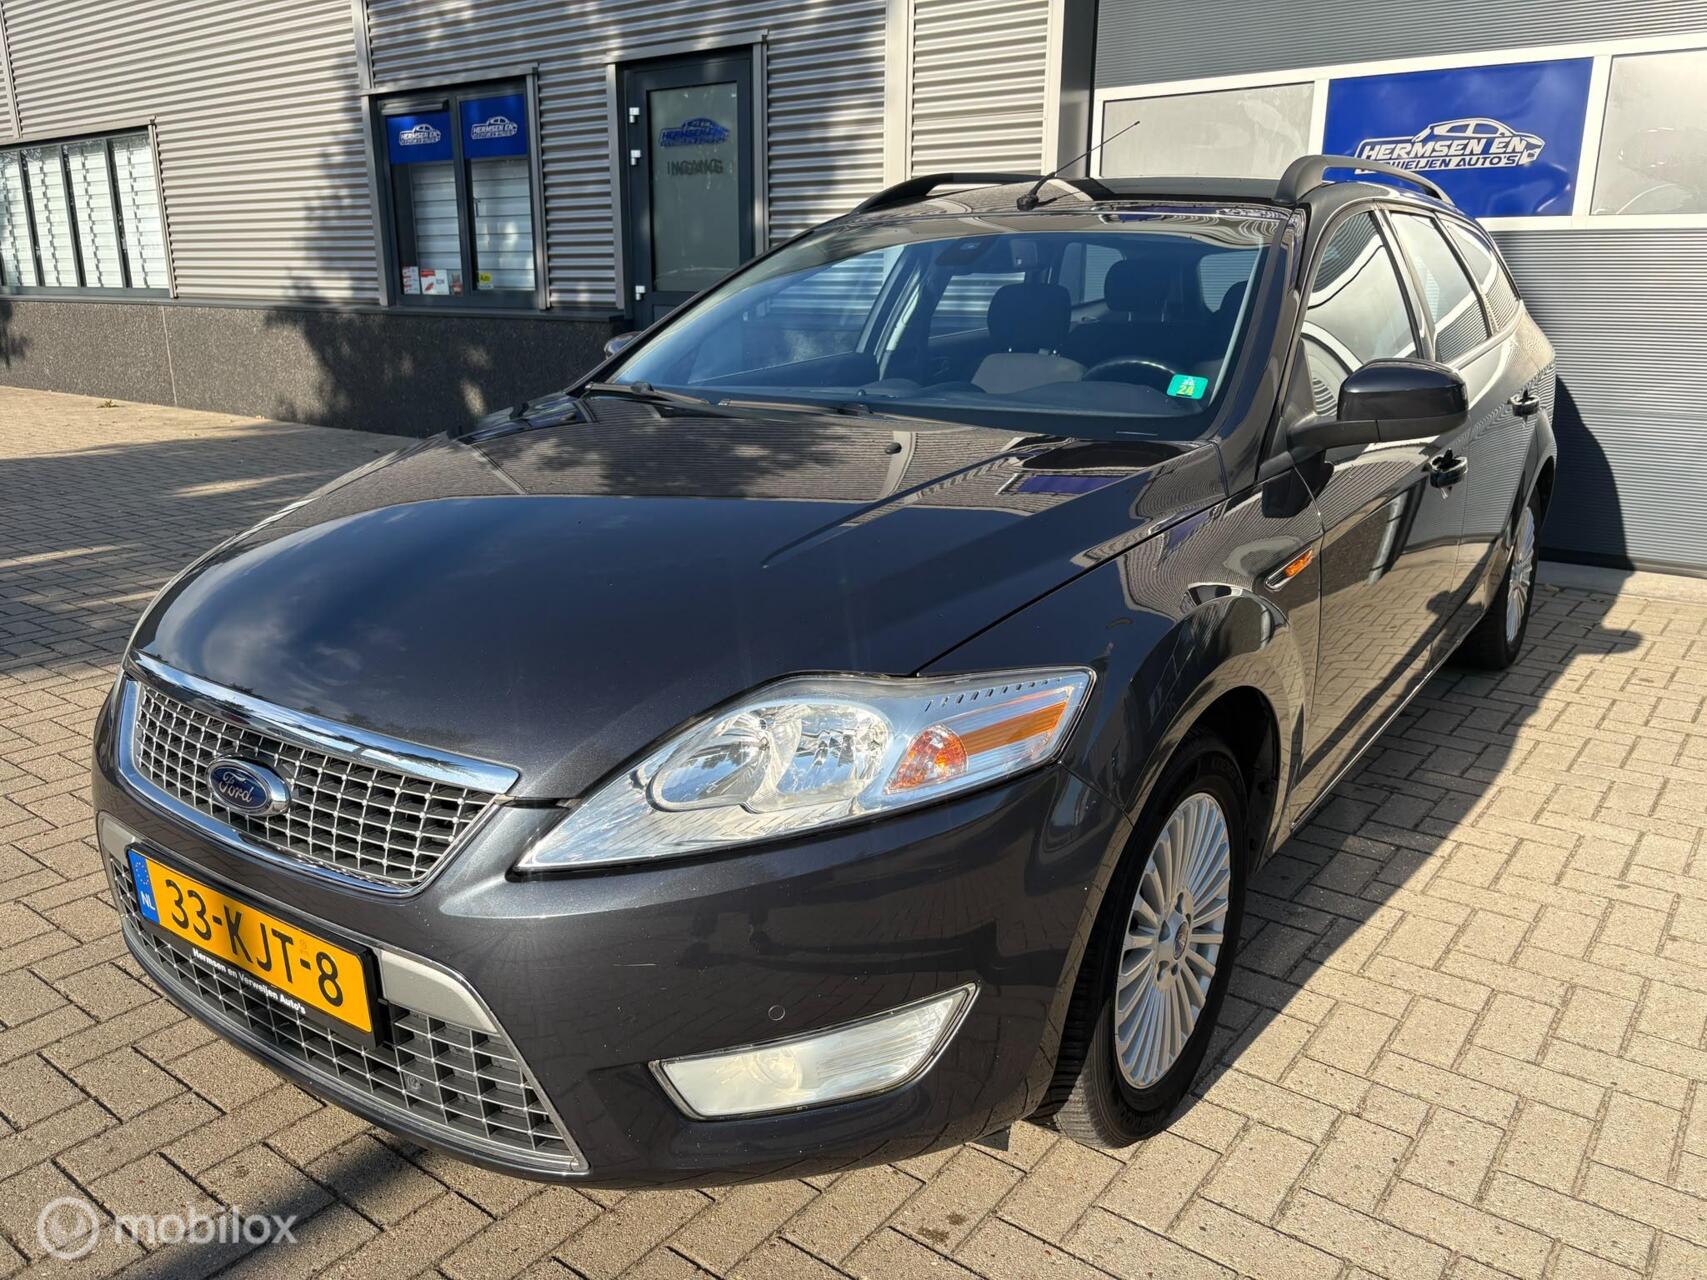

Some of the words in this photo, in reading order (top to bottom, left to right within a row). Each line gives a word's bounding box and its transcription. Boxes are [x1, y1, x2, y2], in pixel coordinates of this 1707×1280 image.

[1362, 139, 1487, 160] HERMSEN
[1489, 136, 1527, 154] EN
[1454, 154, 1519, 168] AUTO'S
[219, 771, 255, 803] Ford
[141, 891, 156, 911] NL
[165, 879, 344, 1008] 33-KJT-8
[192, 947, 227, 973] Hermsen
[227, 968, 238, 979] en
